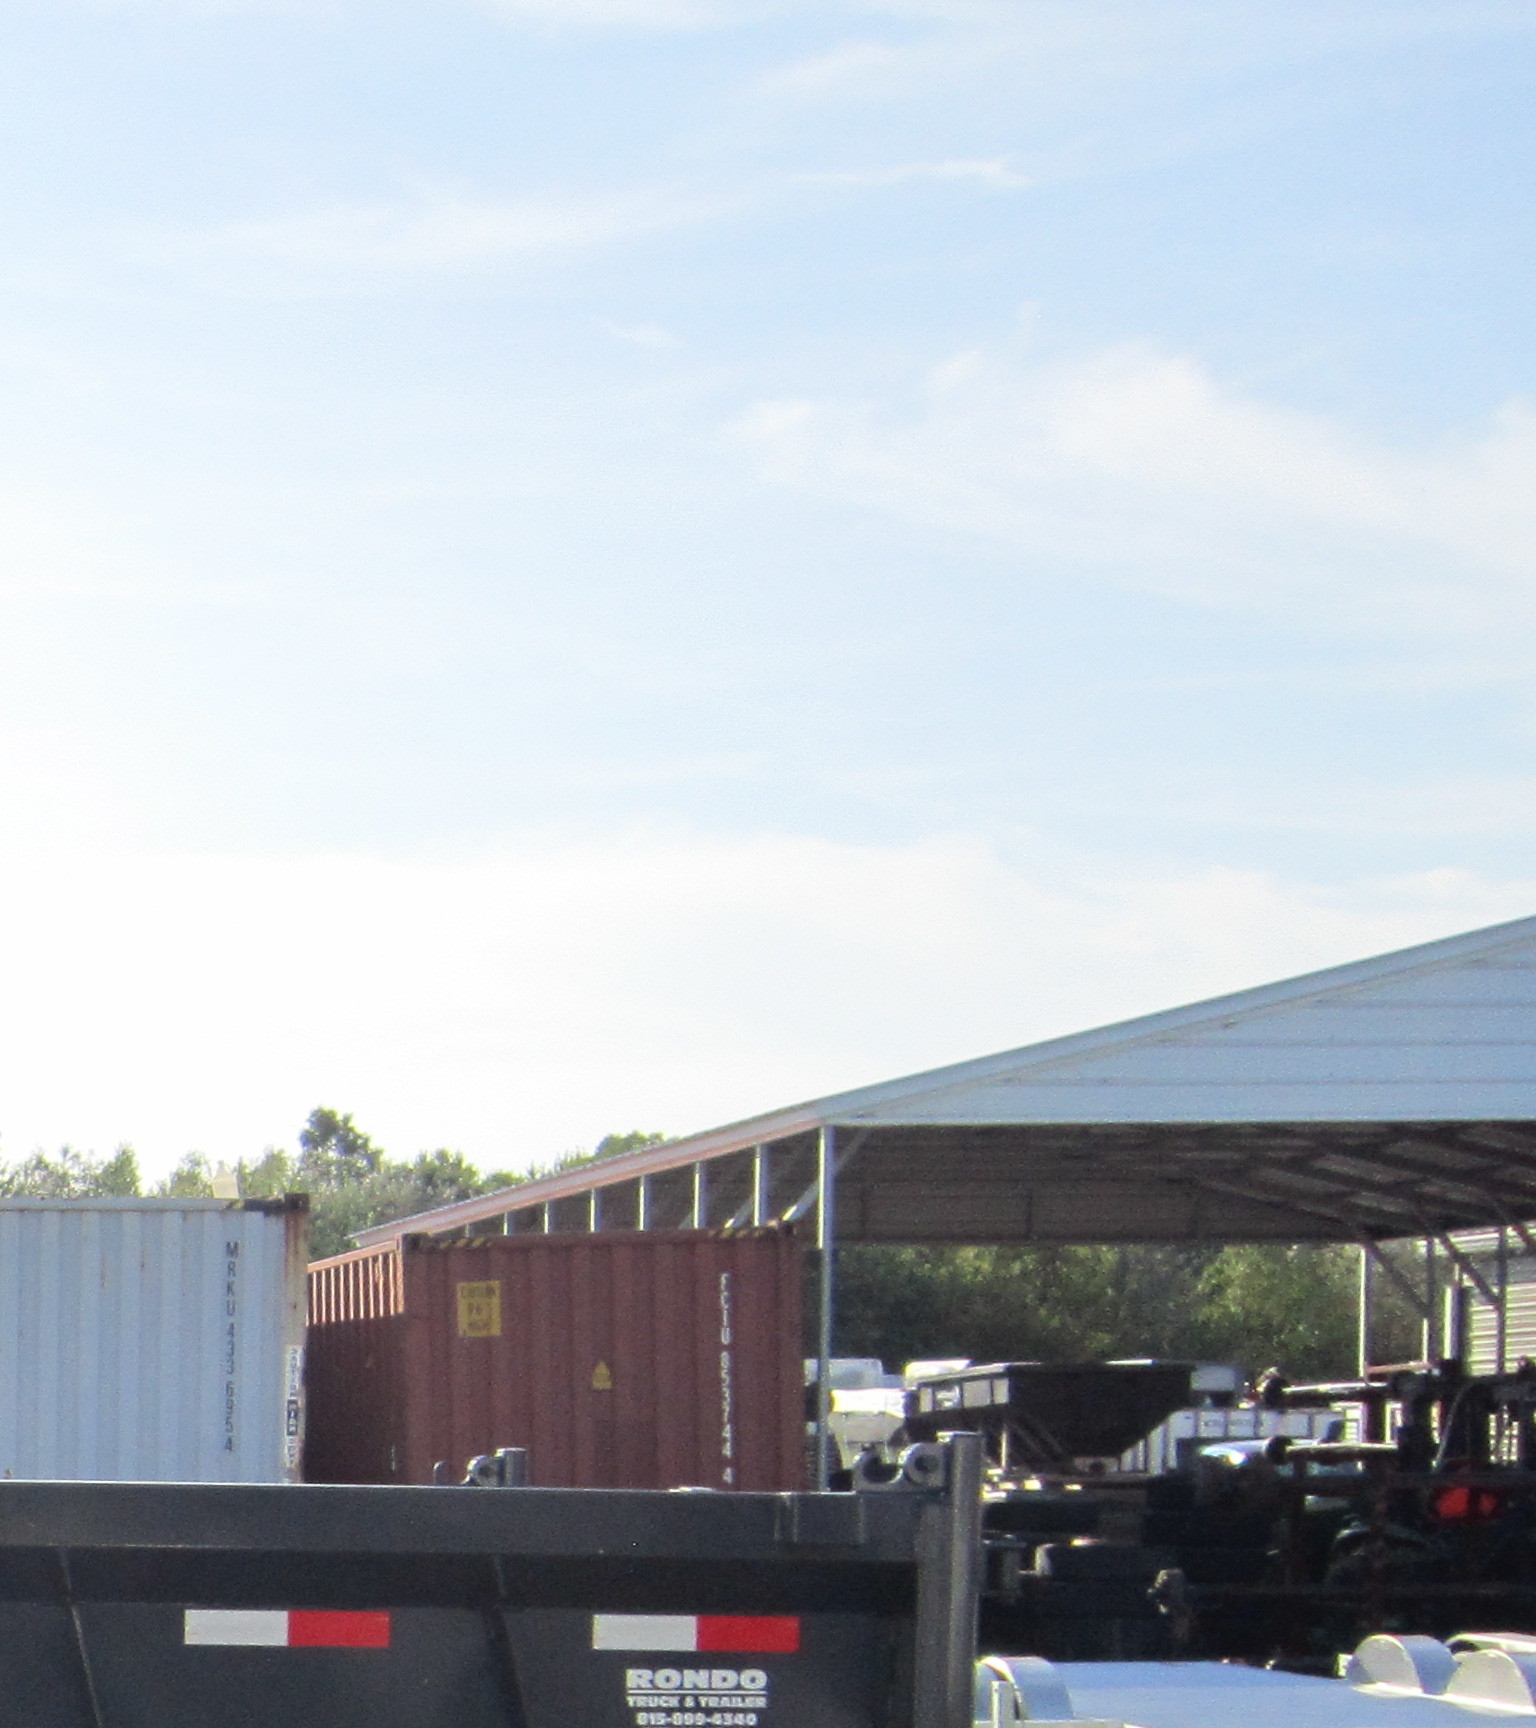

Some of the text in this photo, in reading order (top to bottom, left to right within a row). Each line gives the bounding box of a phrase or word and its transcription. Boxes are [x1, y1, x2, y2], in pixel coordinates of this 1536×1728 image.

[225, 1241, 238, 1317] MRKU
[626, 1668, 768, 1689] RONDO
[627, 1696, 768, 1708] TRUCK & TRAILER
